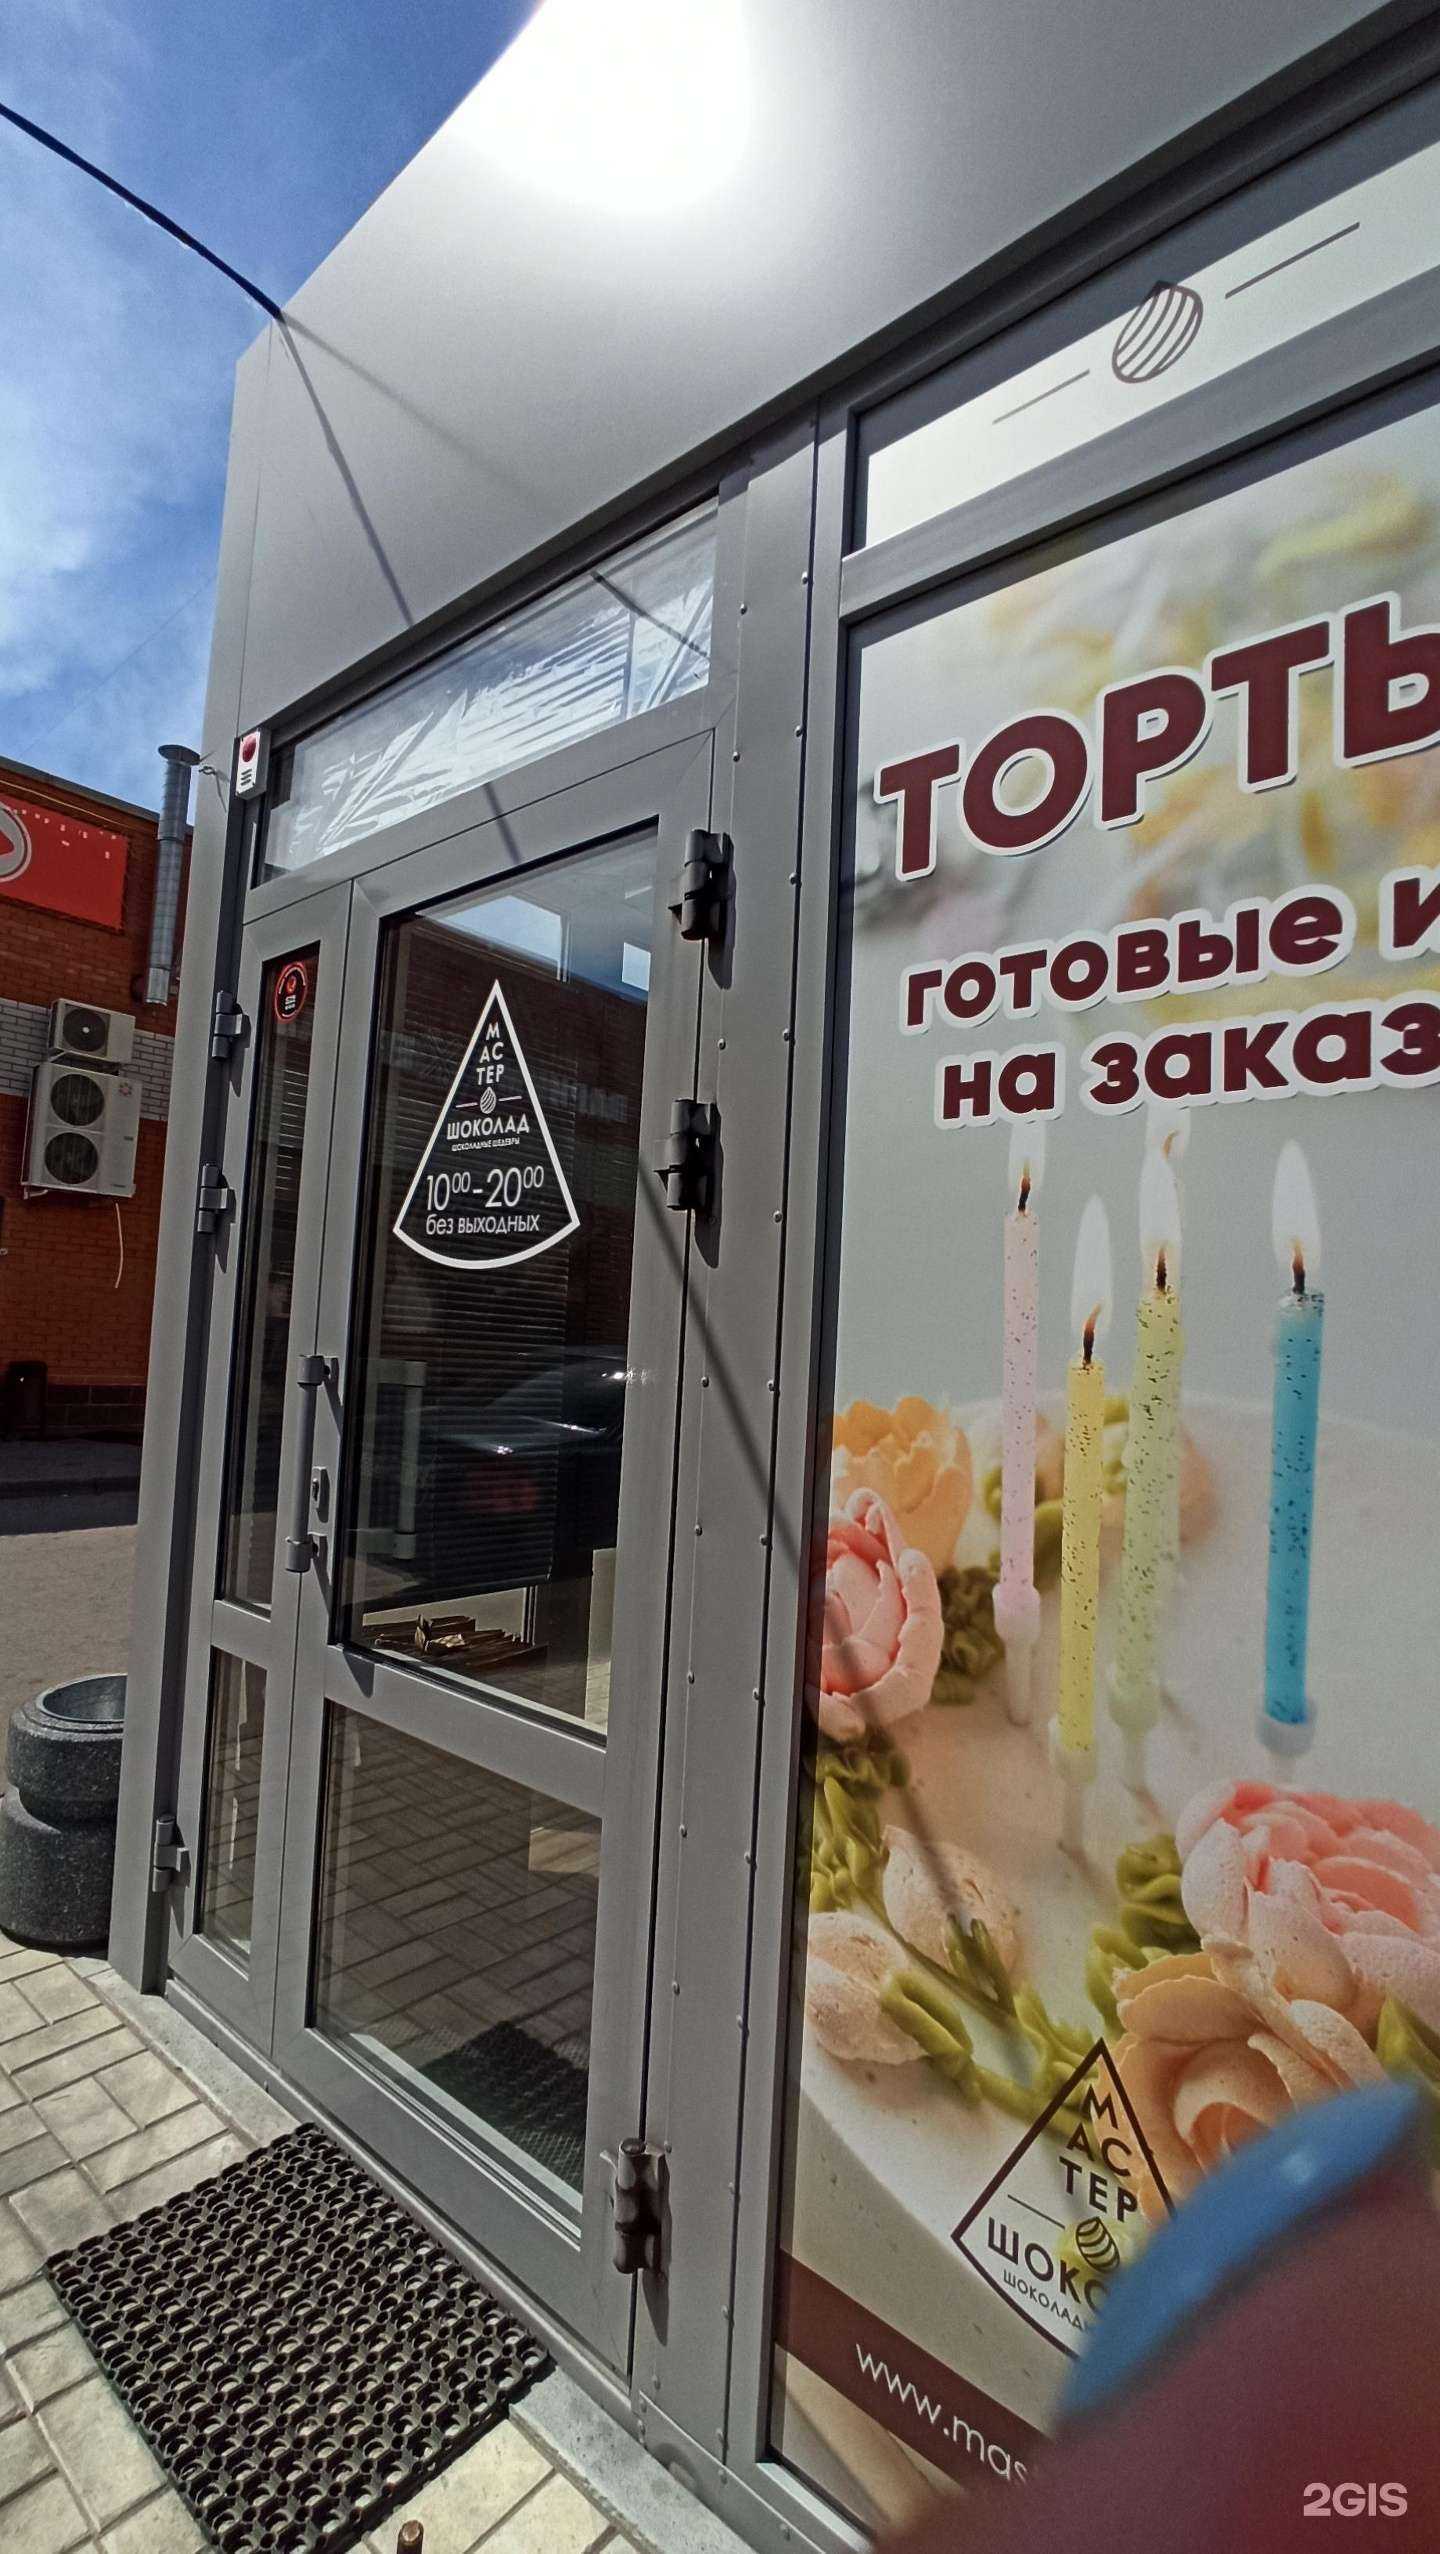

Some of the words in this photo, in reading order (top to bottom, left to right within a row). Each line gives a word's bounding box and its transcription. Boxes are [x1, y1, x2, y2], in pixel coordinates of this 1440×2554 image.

[905, 894, 1345, 1028] готовые
[479, 1042, 504, 1064] АС
[486, 1022, 500, 1041] М
[476, 1064, 504, 1086] ТЕР
[941, 1051, 1057, 1120] на
[1089, 1002, 1440, 1105] заказ
[447, 1113, 530, 1140] ШОКОЛАД
[426, 1213, 454, 1235] без
[457, 1214, 540, 1234] выходных
[1081, 2083, 1119, 2130] М
[1066, 2122, 1132, 2178] АС
[1059, 2155, 1139, 2223] ТЕР
[1002, 2268, 1087, 2333] ШОКОЛАД
